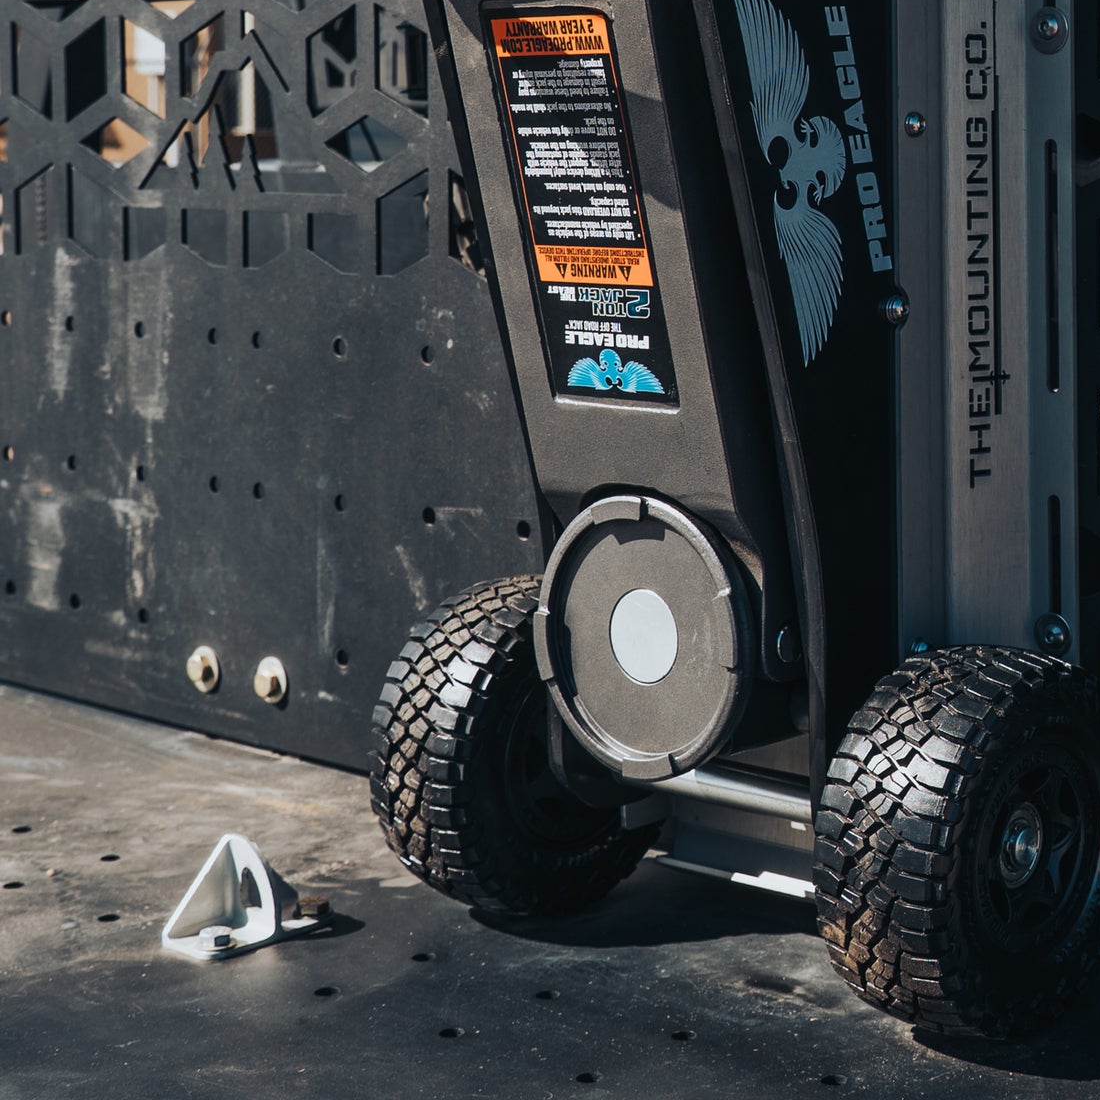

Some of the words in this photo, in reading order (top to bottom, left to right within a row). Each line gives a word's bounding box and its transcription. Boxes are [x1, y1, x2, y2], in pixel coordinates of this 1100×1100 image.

[505, 20, 558, 37] WARRANTY
[559, 19, 586, 34] YEAR
[587, 19, 593, 33] 2
[500, 35, 604, 53] WWW.PROEAGLE.COM
[964, 20, 988, 101] CO.
[824, 5, 873, 164] EAGLE
[855, 171, 893, 273] PRO
[965, 117, 991, 371] MOUNTING
[570, 264, 616, 278] WARNING
[547, 285, 575, 295] BEAST
[578, 286, 623, 302] JACK
[592, 302, 626, 317] TON
[625, 289, 650, 318] 2
[584, 321, 598, 330] ROAD
[599, 322, 610, 331] OFF
[611, 322, 621, 332] THE
[565, 331, 614, 347] EAGLE
[616, 334, 649, 349] PRO
[969, 388, 992, 489] THE
